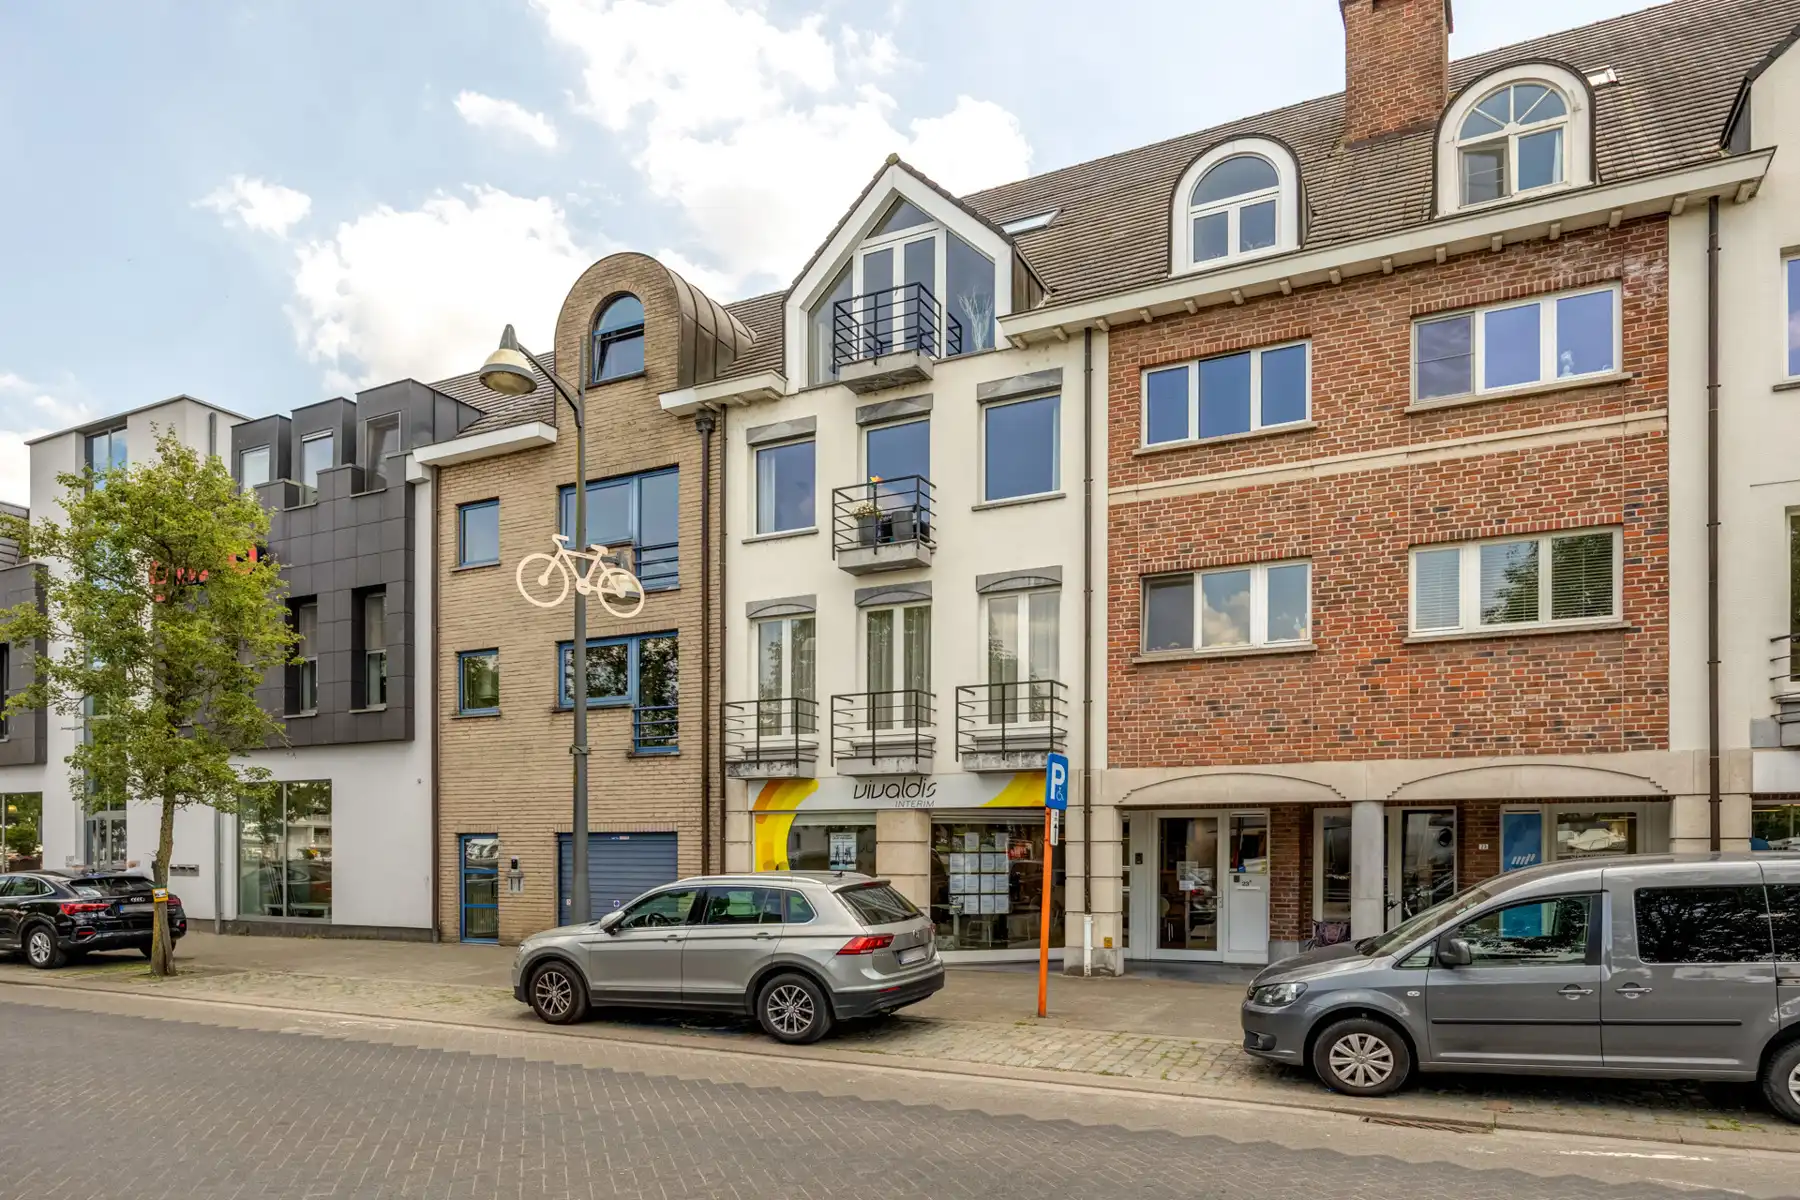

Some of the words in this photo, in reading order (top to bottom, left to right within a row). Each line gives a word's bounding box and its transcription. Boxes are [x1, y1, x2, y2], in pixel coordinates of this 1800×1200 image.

[853, 776, 937, 799] vivaldis
[1050, 762, 1066, 800] P
[895, 800, 935, 808] INTERIM
